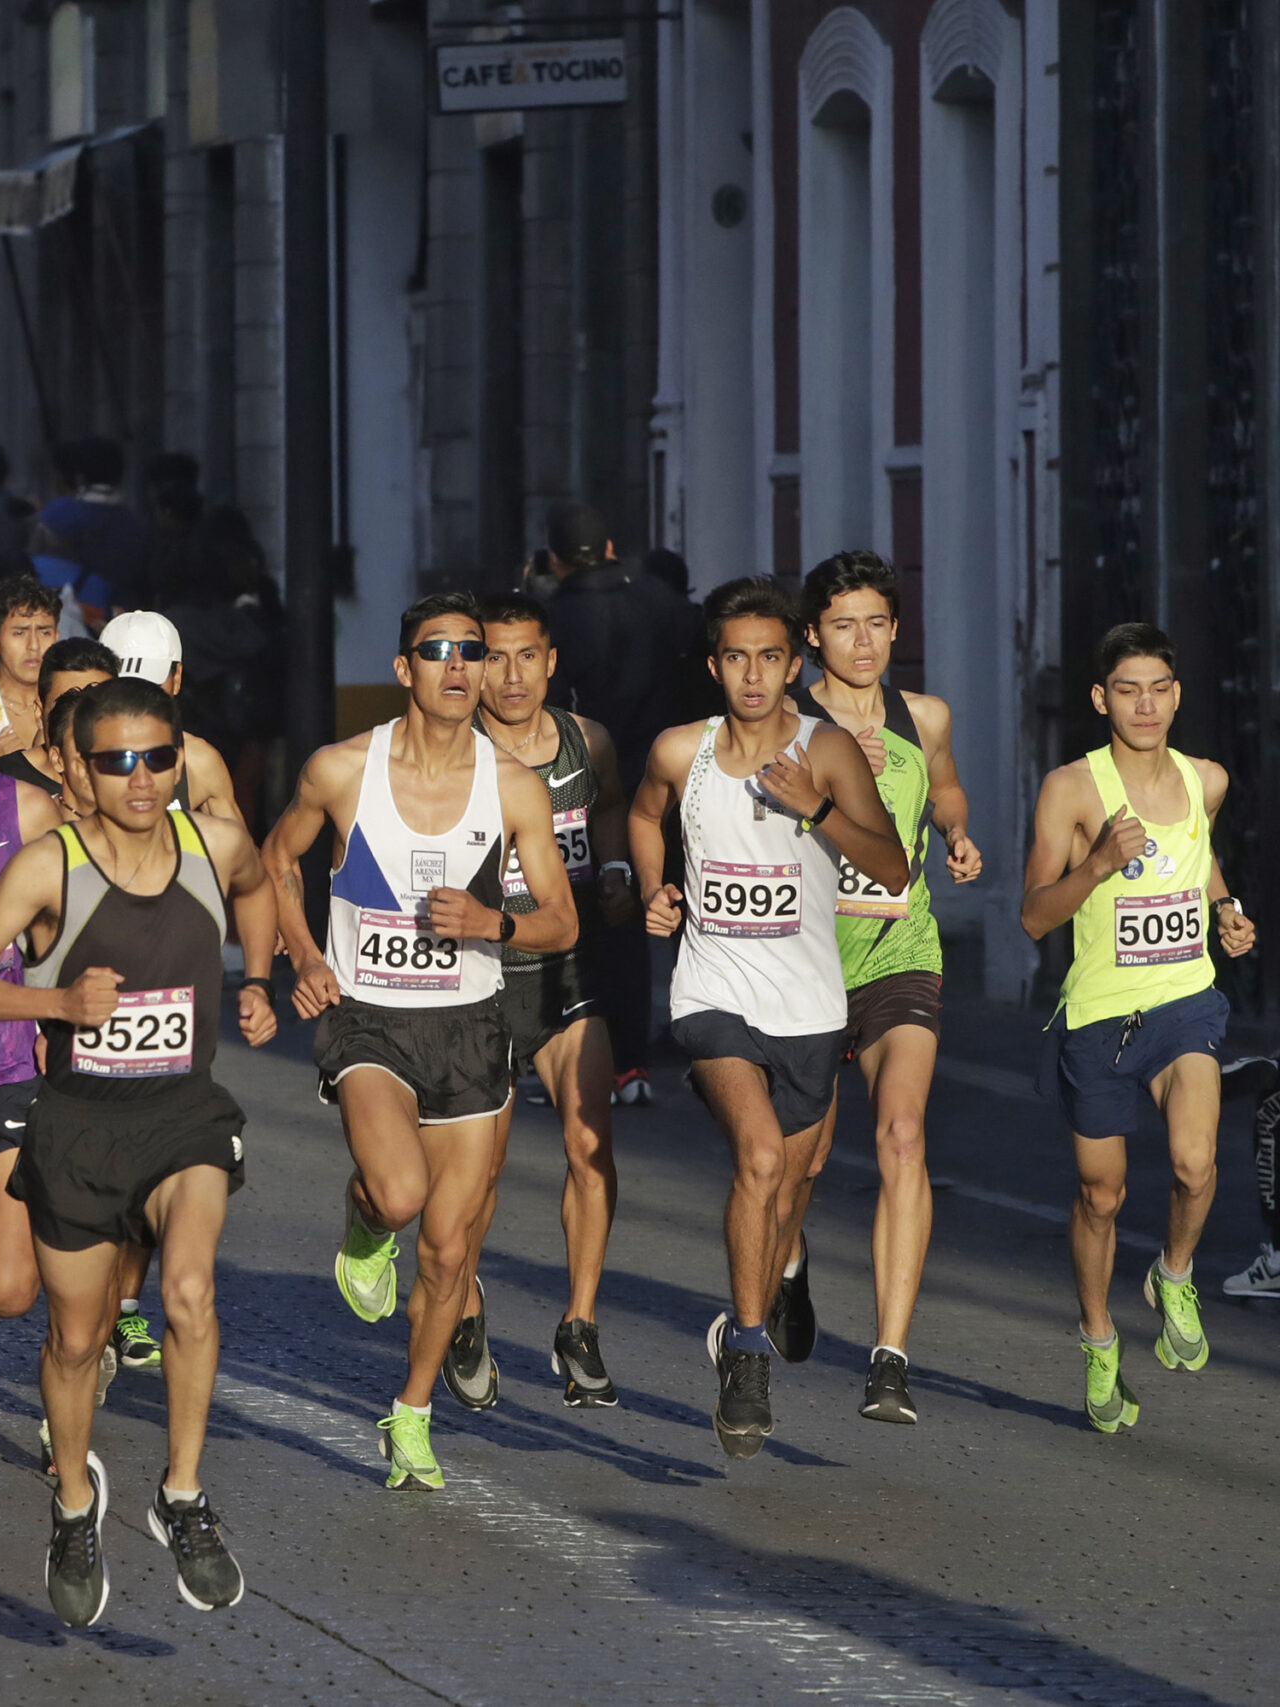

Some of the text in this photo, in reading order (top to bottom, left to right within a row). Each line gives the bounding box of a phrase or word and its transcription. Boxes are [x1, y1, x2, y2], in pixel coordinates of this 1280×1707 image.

[442, 58, 513, 88] CAFÉ
[532, 56, 624, 83] TOCINO
[415, 868, 442, 876] ARENAS
[422, 876, 434, 884] MX
[702, 880, 797, 917] 5992
[1118, 907, 1200, 946] 5095
[360, 932, 459, 970] 4883
[78, 1012, 188, 1052] 5523
